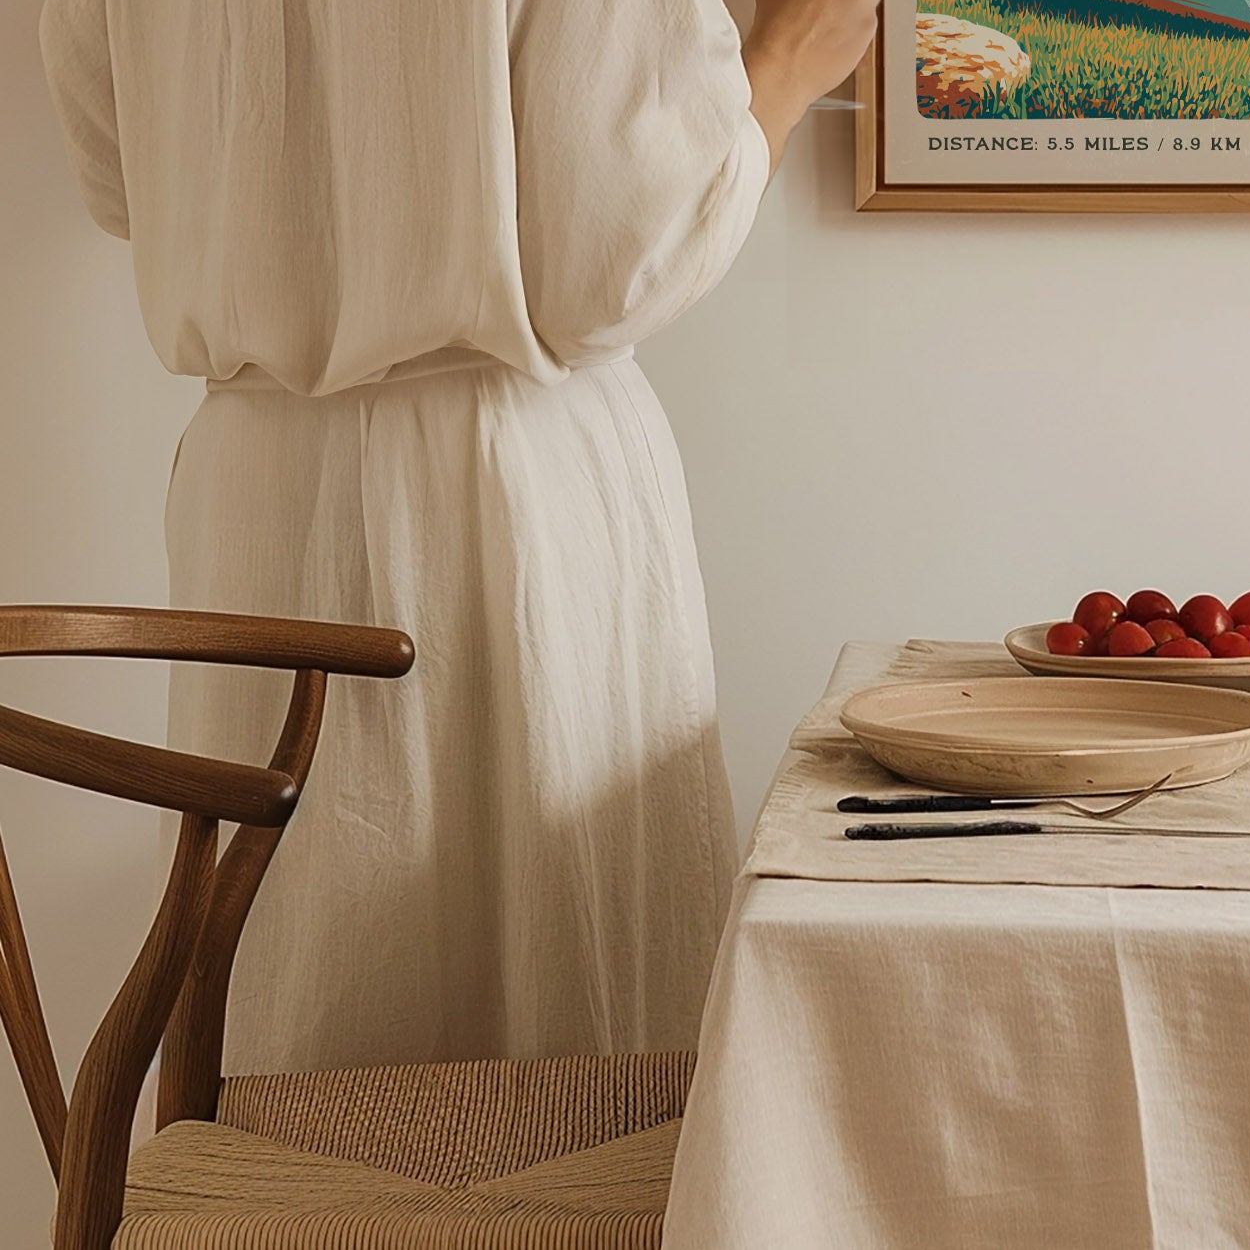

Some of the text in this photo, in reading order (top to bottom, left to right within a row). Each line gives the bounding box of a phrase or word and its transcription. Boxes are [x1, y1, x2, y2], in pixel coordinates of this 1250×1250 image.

[928, 136, 1241, 152] DISTANCE: 5.5 MILES / 8.9 KM
